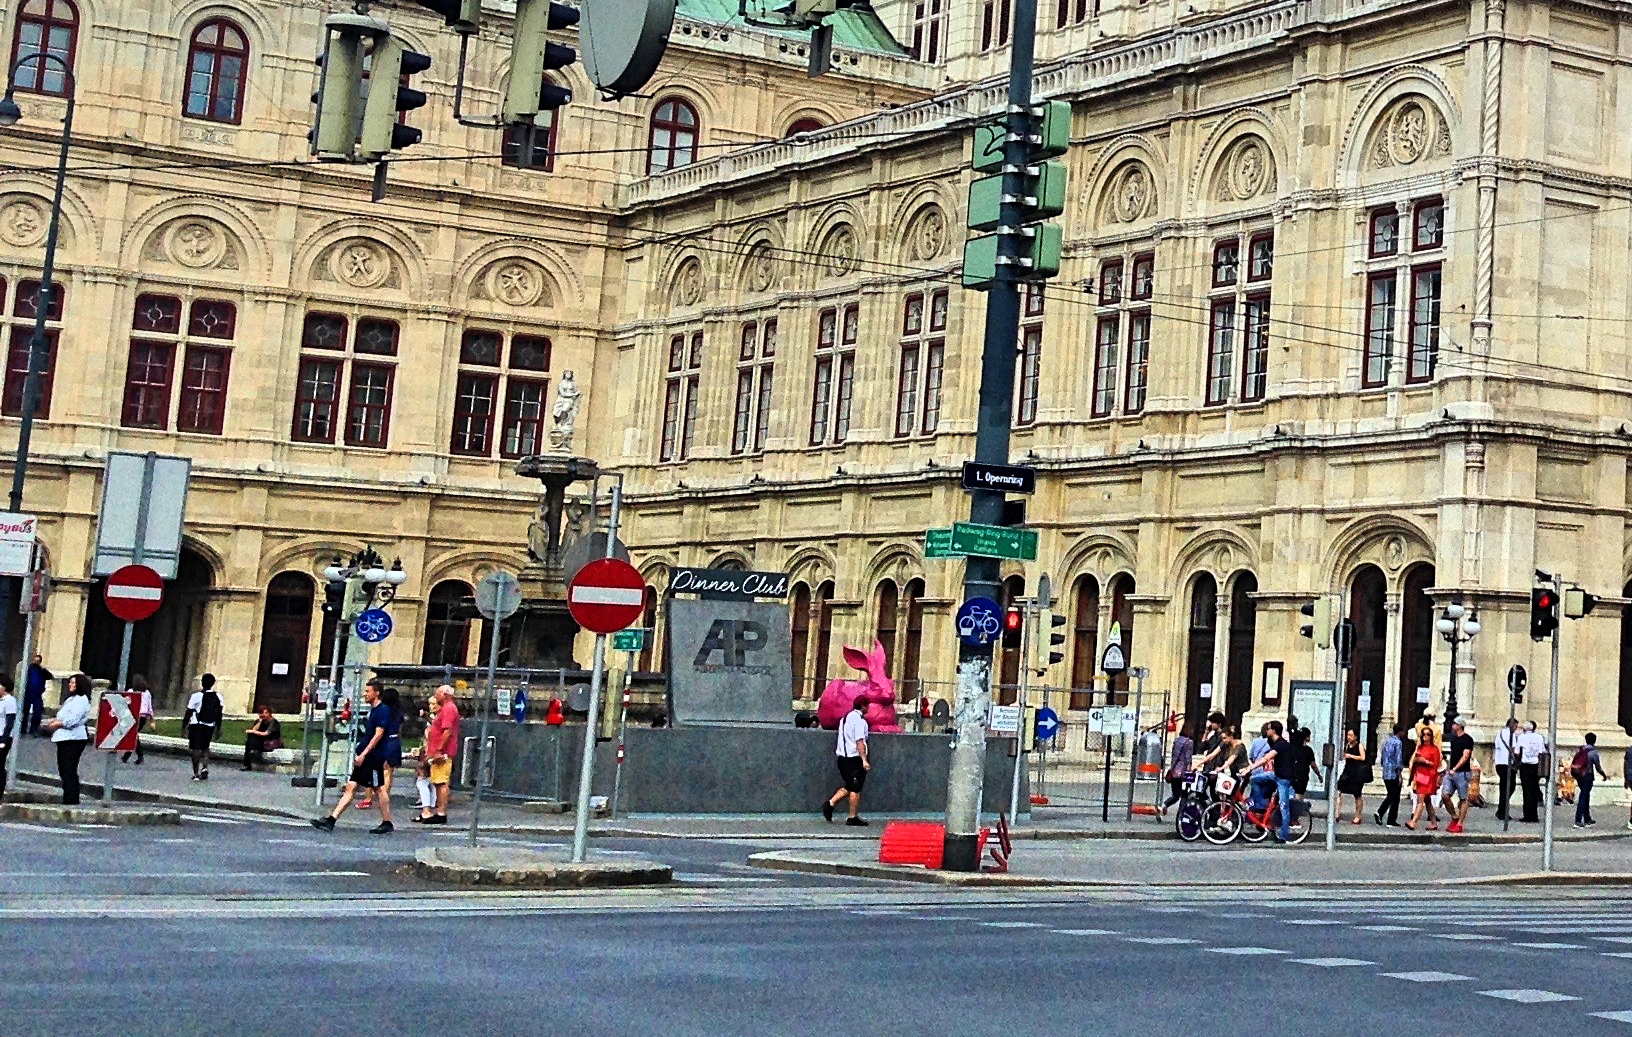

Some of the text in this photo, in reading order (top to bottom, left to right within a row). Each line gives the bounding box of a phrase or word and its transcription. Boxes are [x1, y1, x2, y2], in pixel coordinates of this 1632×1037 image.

[985, 471, 1024, 487] Opernring
[671, 570, 788, 595] Dinner Club
[693, 619, 769, 667] AP
